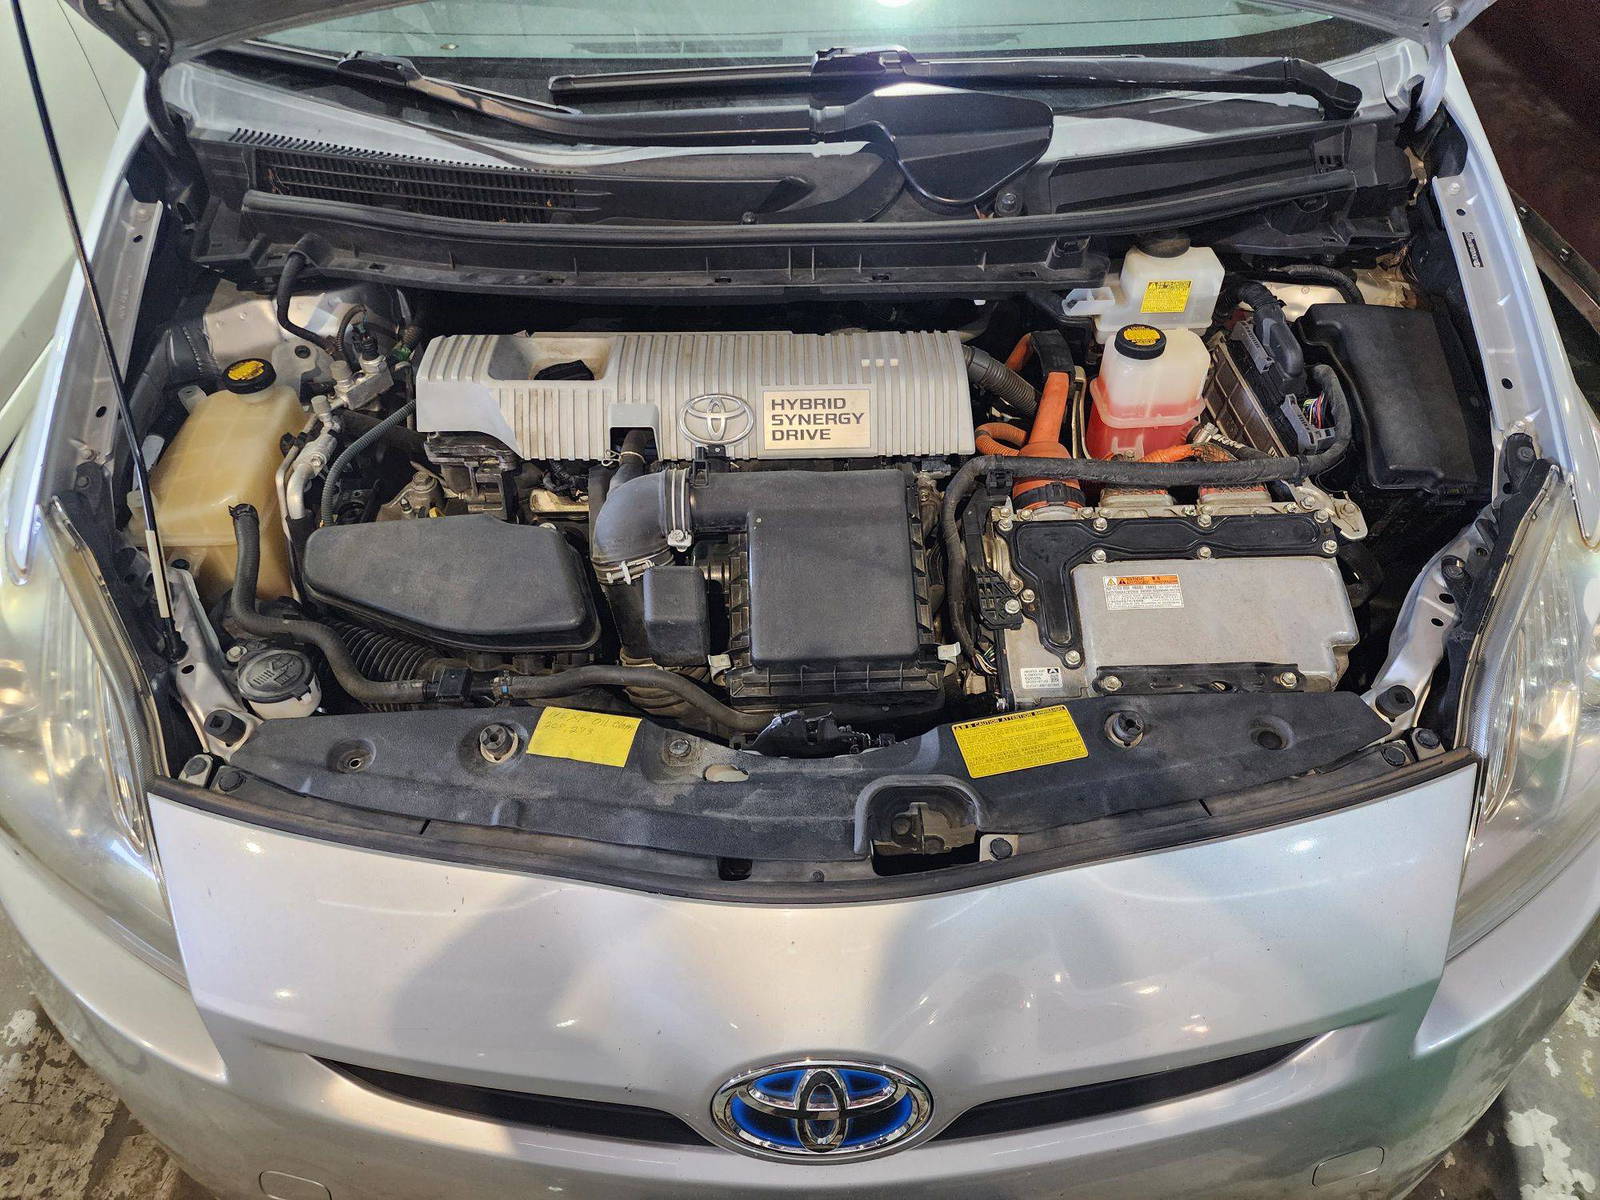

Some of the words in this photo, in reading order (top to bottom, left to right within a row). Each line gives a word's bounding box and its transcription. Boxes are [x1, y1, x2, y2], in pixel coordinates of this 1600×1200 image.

[771, 398, 846, 410] HYBRID
[771, 412, 864, 426] SYNERGY
[771, 428, 831, 441] DRIVE
